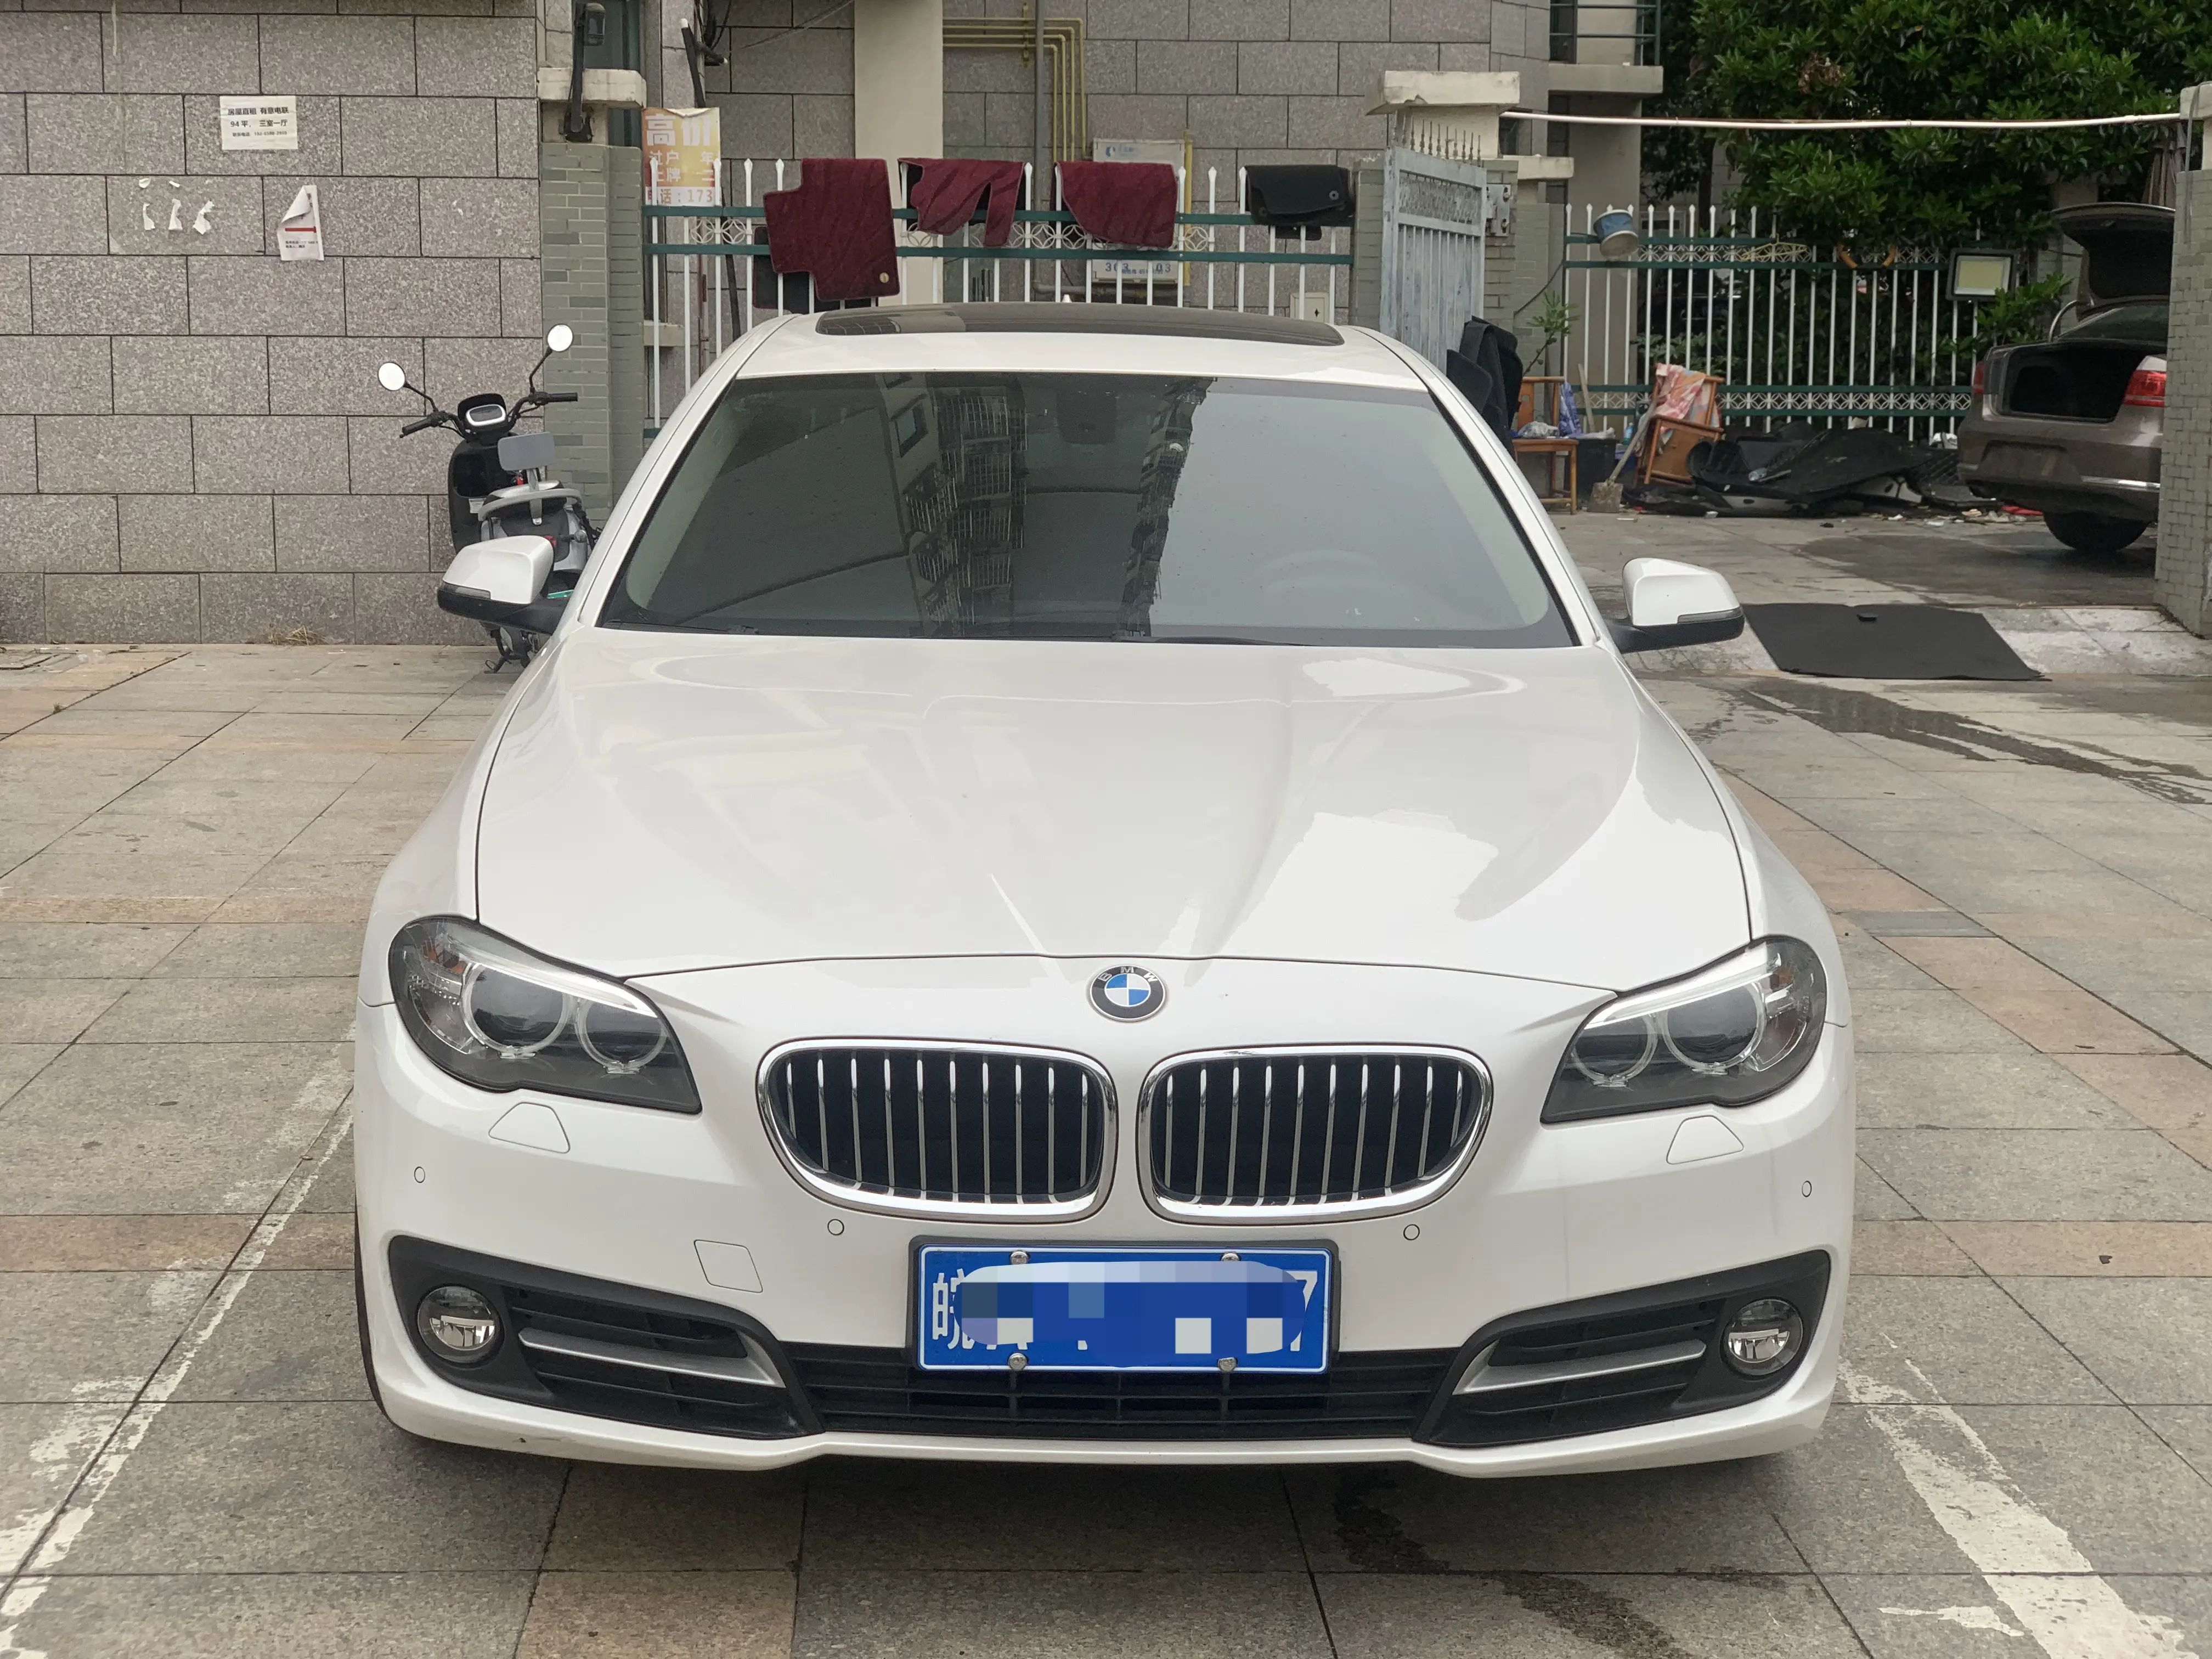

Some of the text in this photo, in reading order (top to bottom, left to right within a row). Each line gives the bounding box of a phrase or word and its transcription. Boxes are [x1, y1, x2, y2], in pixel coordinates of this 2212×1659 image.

[259, 119, 287, 127] 三室一厅
[1097, 966, 1158, 982] BMW
